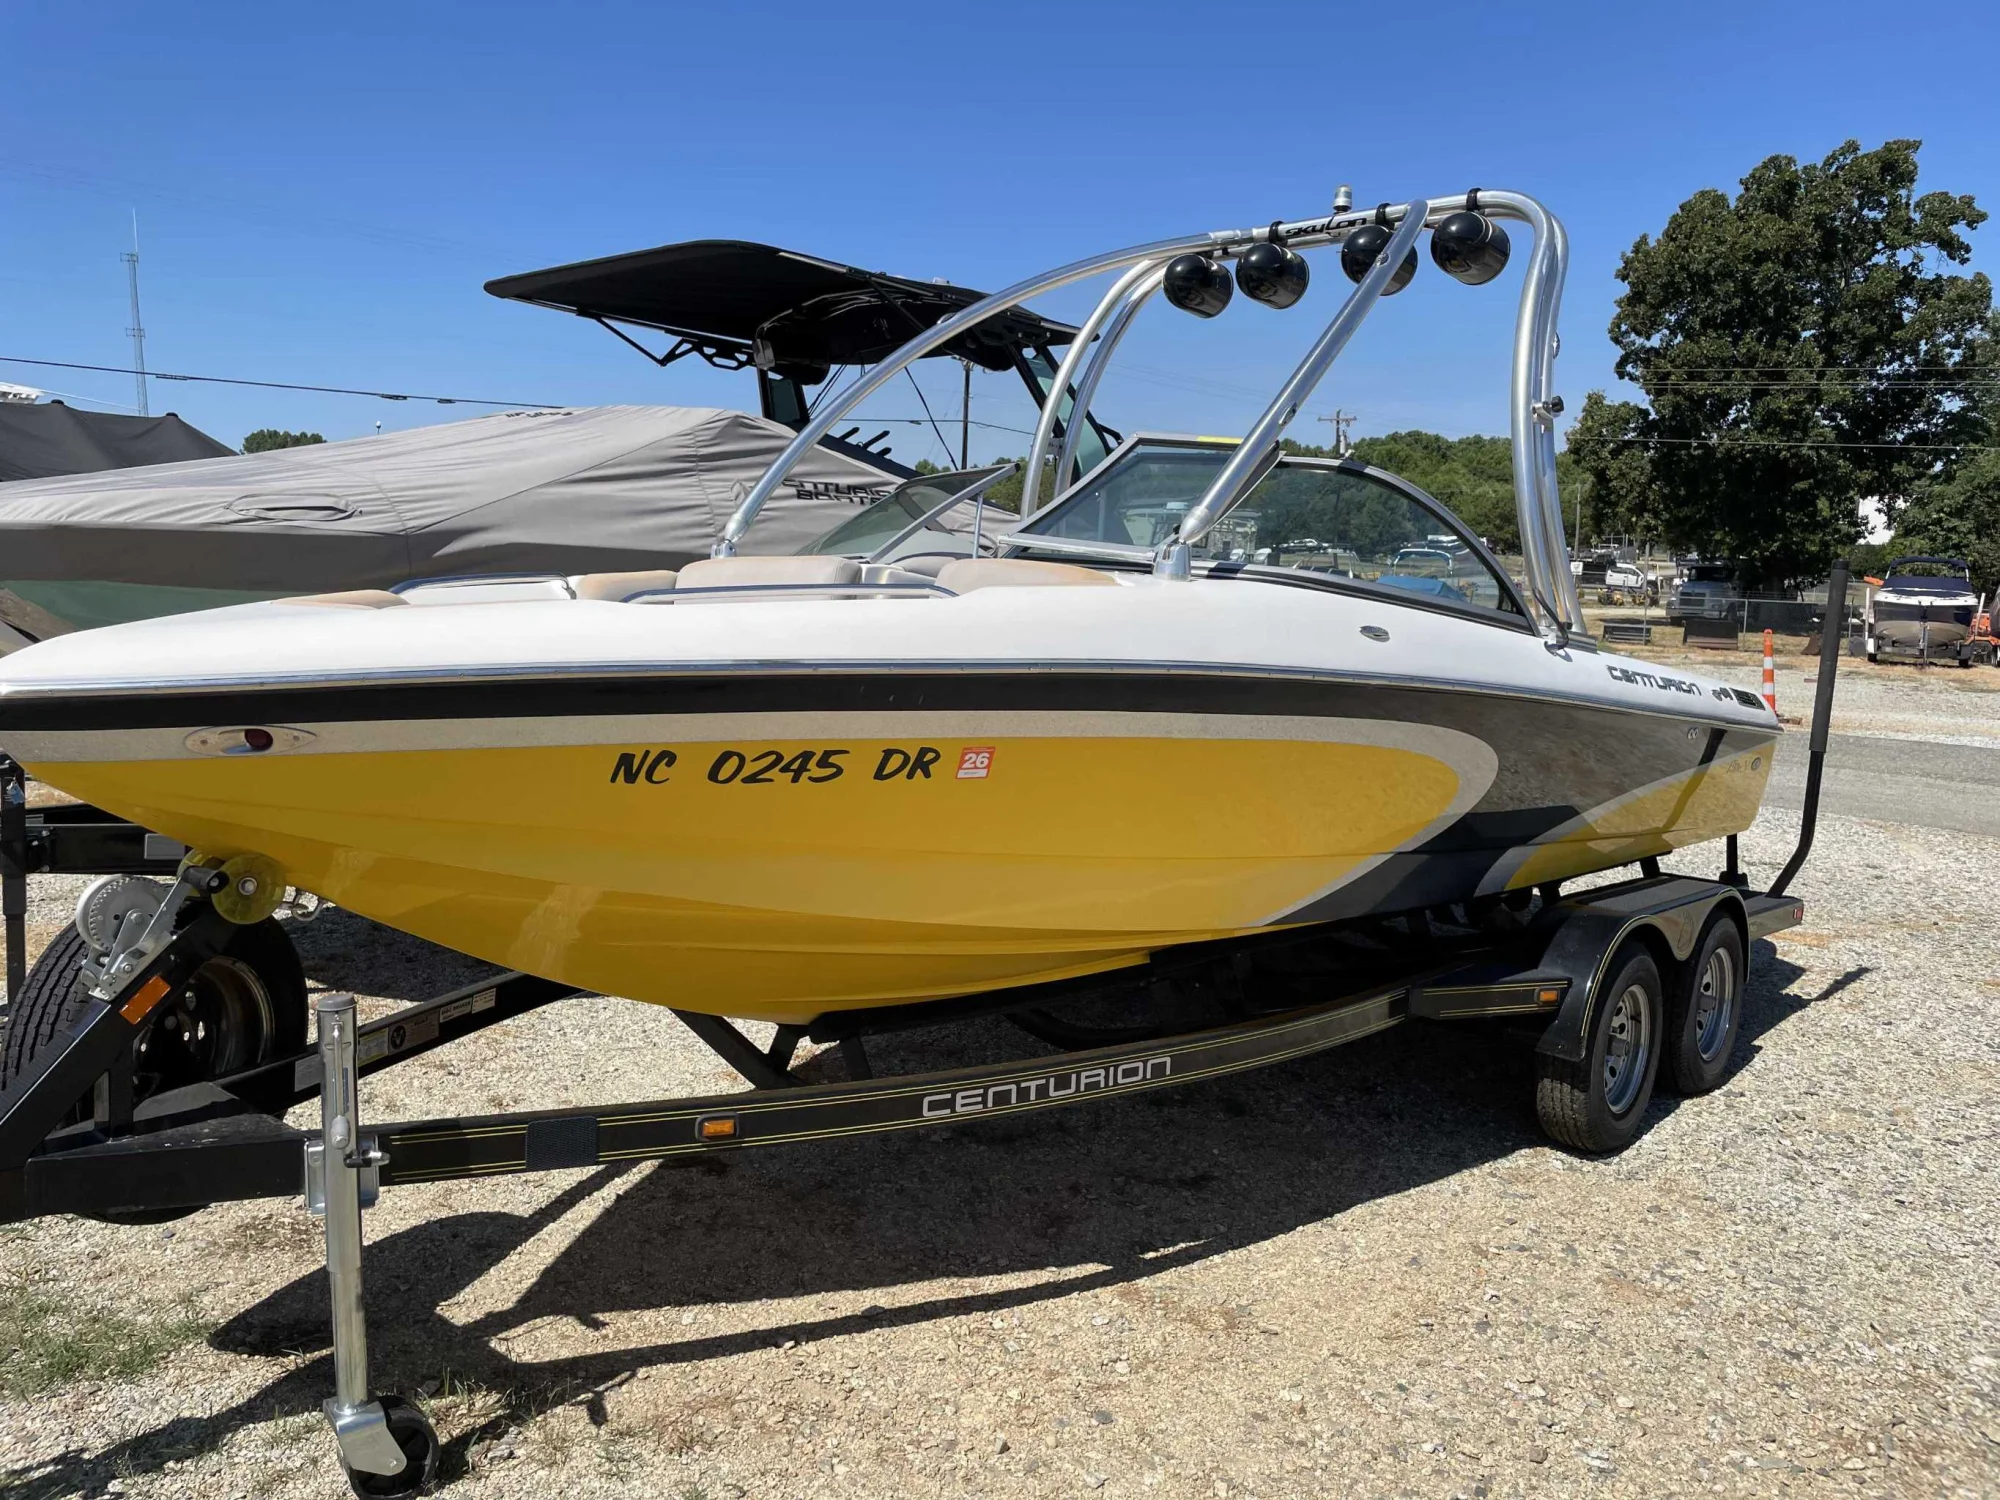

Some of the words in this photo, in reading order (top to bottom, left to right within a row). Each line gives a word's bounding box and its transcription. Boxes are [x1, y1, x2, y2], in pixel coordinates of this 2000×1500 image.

[609, 749, 677, 785] NC
[706, 749, 850, 784] 0245
[872, 746, 941, 781] DR
[961, 752, 990, 769] 26
[922, 1056, 1171, 1117] CENTURION
